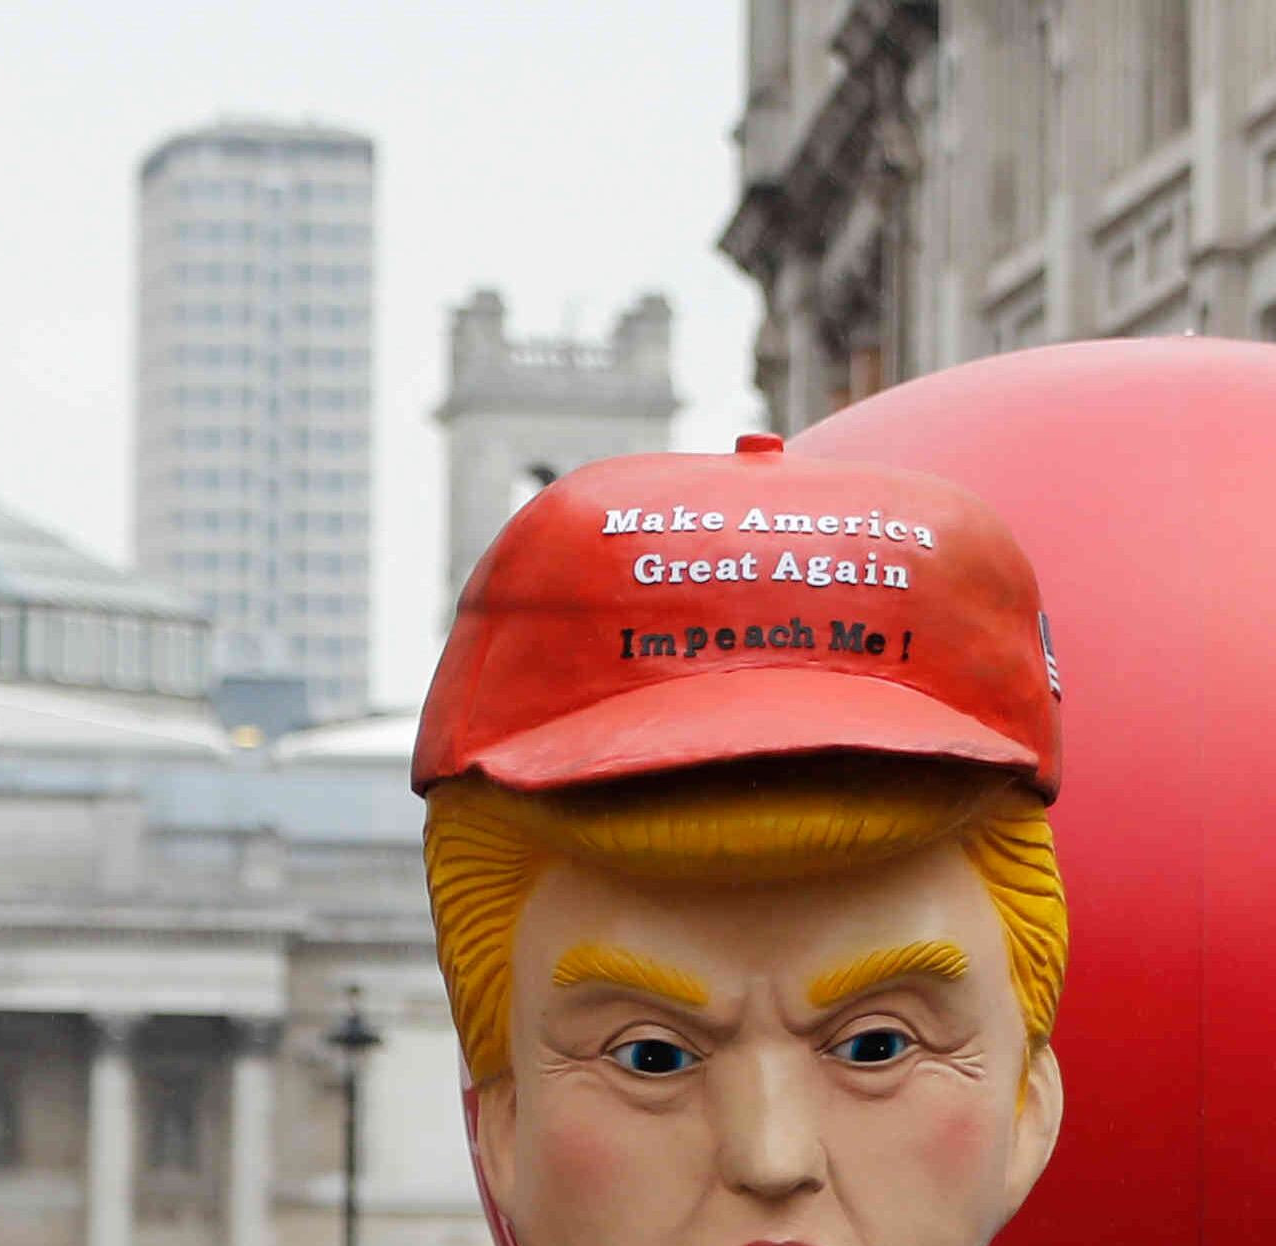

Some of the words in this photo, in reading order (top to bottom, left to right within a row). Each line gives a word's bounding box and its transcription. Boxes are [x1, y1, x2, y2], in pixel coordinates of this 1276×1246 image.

[601, 505, 724, 536] Make
[738, 507, 935, 548] America
[633, 553, 757, 585] Great
[772, 551, 910, 589] Again
[620, 618, 815, 660] Impeach
